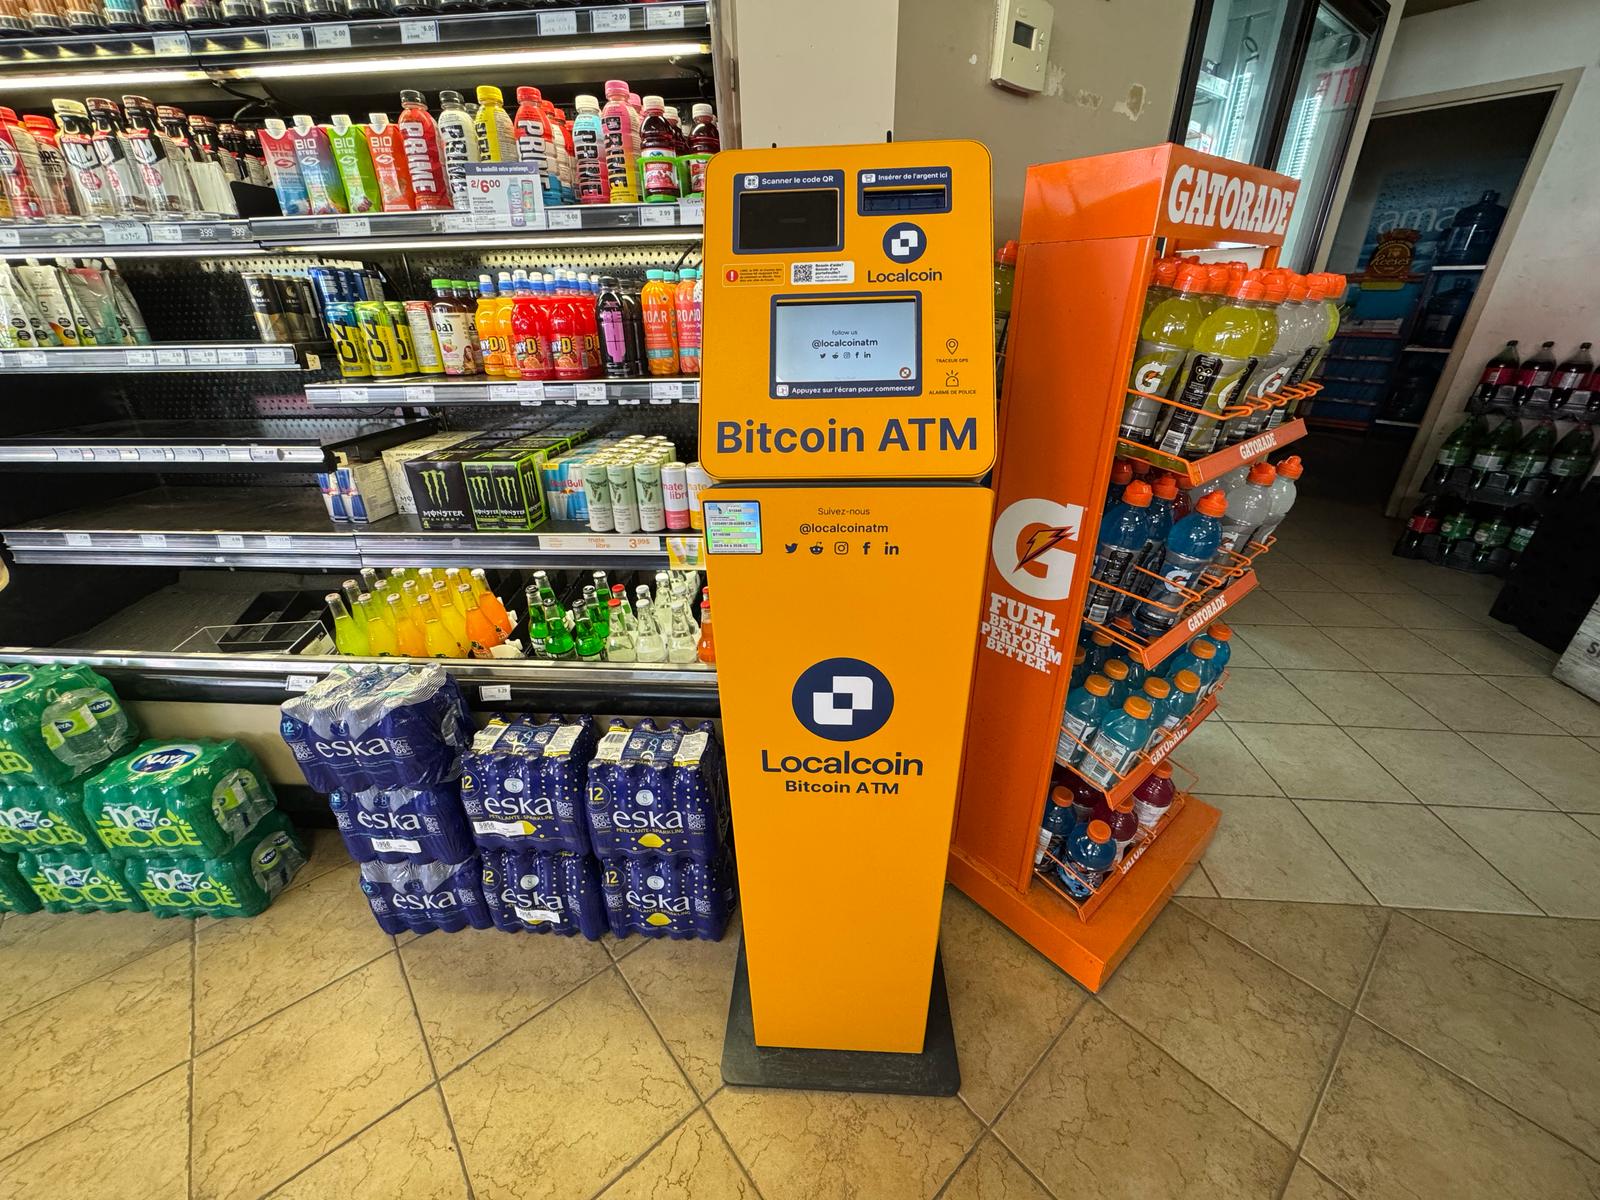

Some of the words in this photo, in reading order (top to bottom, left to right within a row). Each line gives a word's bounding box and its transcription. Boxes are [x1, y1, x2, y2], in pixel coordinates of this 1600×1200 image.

[294, 138, 317, 150] BIO
[334, 137, 354, 148] BIO
[370, 136, 392, 147] BIO
[400, 122, 437, 194] PRIME
[574, 130, 603, 196] PRIME
[762, 177, 792, 185] Scanner
[819, 175, 834, 184] QR
[878, 173, 898, 181] Insérer
[911, 172, 937, 182] l'argent
[1168, 164, 1295, 235] GATORADE
[868, 268, 942, 283] Localcoin
[812, 338, 878, 349] @localcoinatm
[1135, 361, 1168, 394] G
[792, 386, 821, 394] Appuyez
[716, 418, 864, 454] Bitcoin
[878, 417, 978, 452] ATM
[1239, 432, 1278, 460] GATORADE
[567, 479, 584, 487] Bull
[817, 507, 870, 516] Suivez-nous
[799, 523, 889, 535] @localcoinatm
[992, 498, 1084, 601] G
[989, 592, 1060, 638] FUEL
[1187, 594, 1228, 632] GATORADE
[989, 612, 1055, 650] BETTER.
[981, 621, 1062, 666] PERFORM
[986, 636, 1051, 674] BETTER.
[315, 738, 390, 758] eska
[139, 754, 188, 767] NAYA
[761, 749, 923, 776] Localcoin
[462, 776, 474, 789] 12
[785, 780, 850, 793] Bitcoin
[856, 782, 899, 794] ATM
[588, 787, 604, 801] 12
[484, 797, 553, 816] eska
[357, 810, 421, 830] eska
[613, 810, 684, 829] eska
[483, 870, 494, 882] 12
[605, 871, 619, 884] 12
[392, 891, 457, 910] eska
[501, 888, 563, 910] eska
[626, 890, 690, 912] eska
